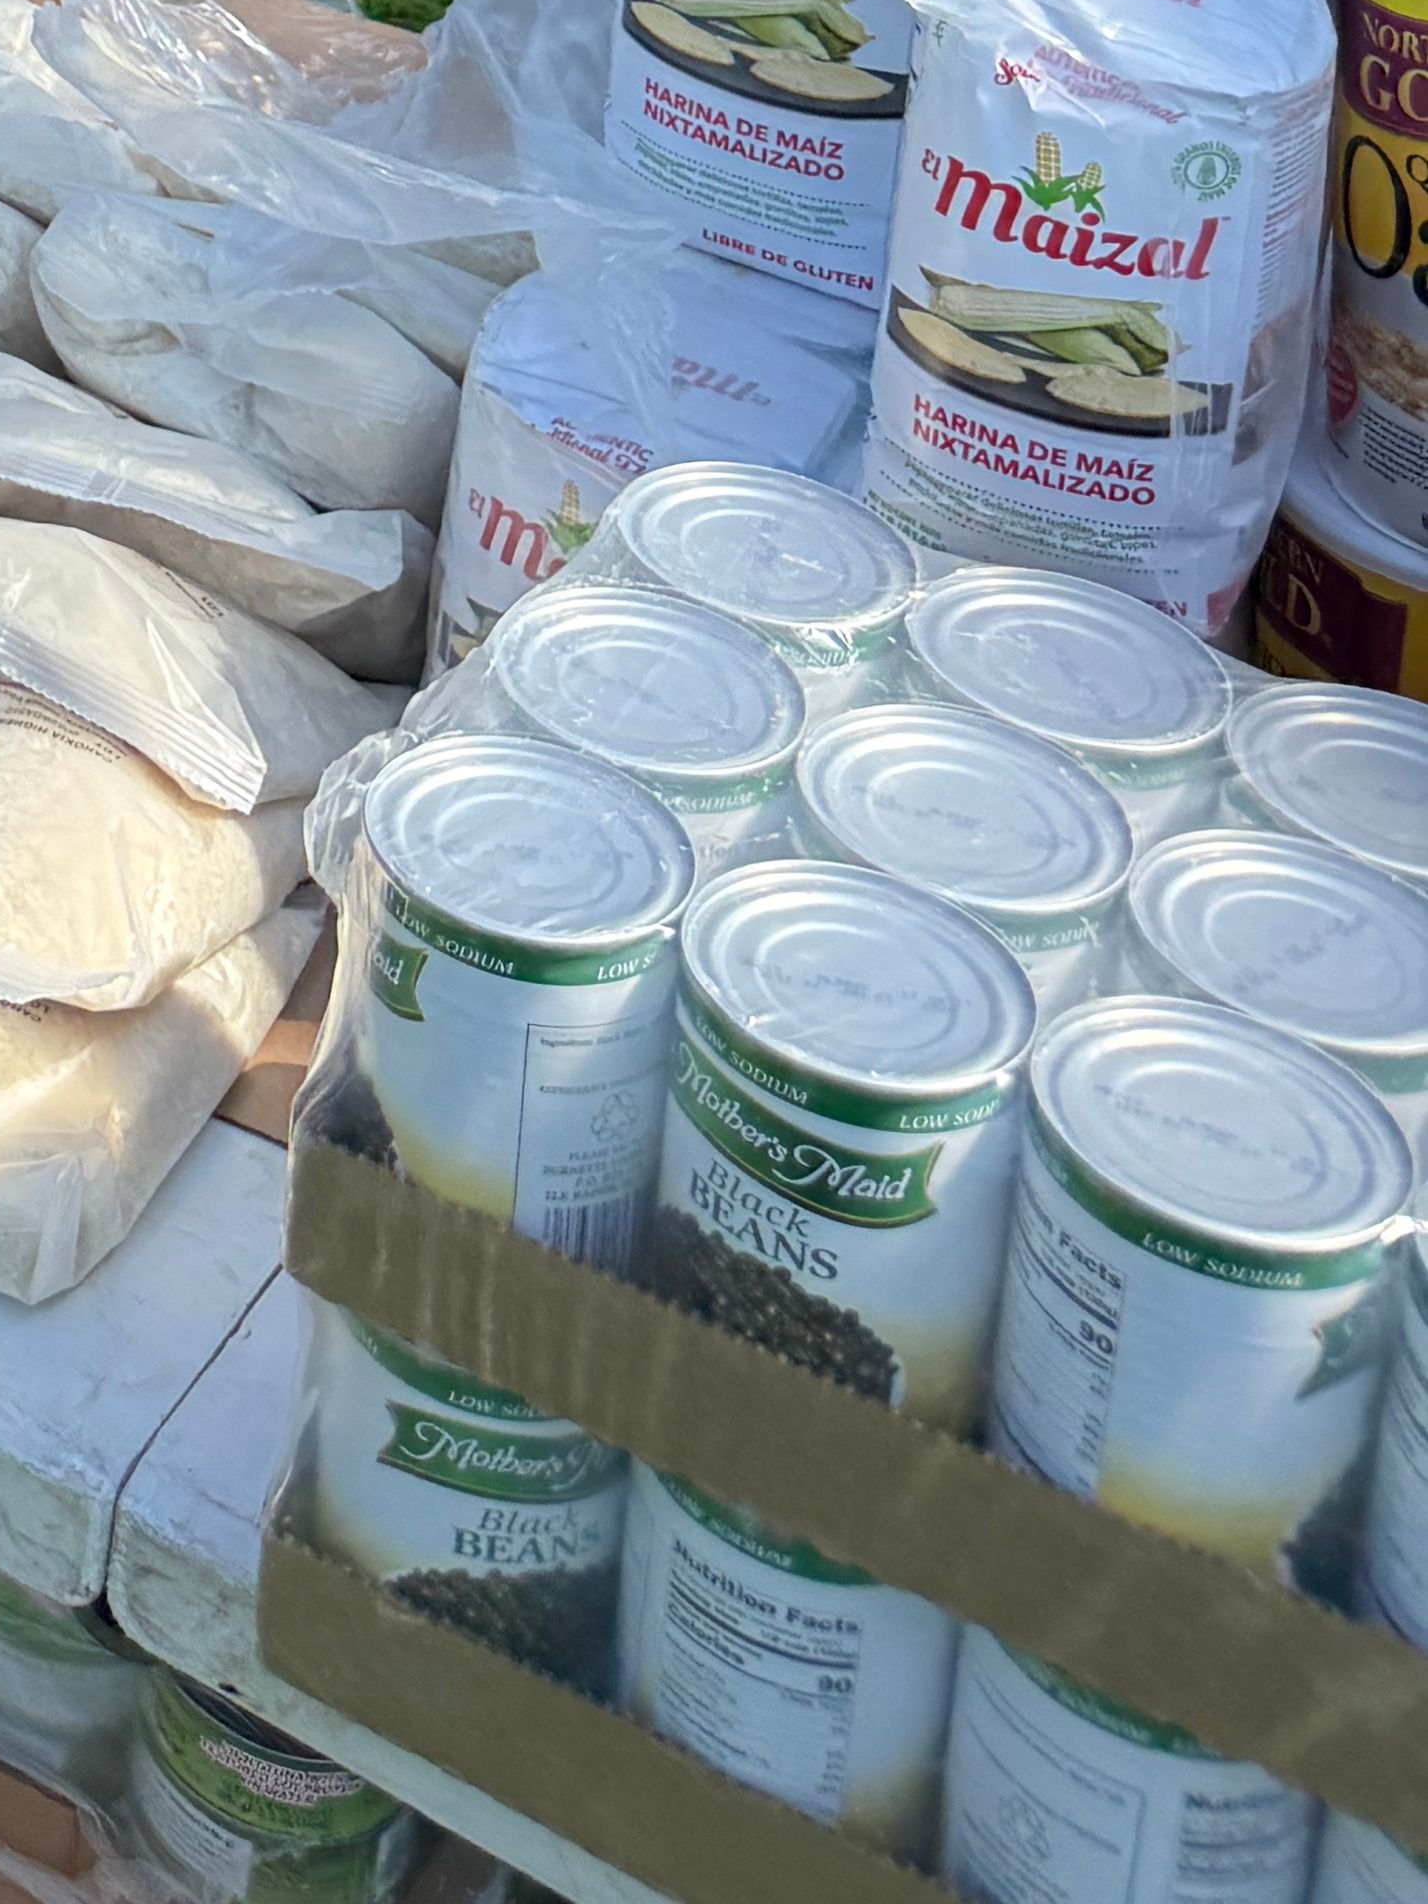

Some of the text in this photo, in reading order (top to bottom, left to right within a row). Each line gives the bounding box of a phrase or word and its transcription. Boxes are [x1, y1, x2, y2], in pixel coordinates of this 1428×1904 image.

[644, 100, 844, 181] NIXTAMALIZADO
[645, 77, 844, 160] HARINA DE MAÍZ
[921, 148, 941, 181] El
[934, 155, 1219, 281] Maizal
[702, 228, 874, 291] LIBRE DE GLUTEN
[913, 394, 1156, 482] HARINA DE MAÍZ
[913, 418, 1156, 506] NIXTAMALIZADO
[369, 934, 405, 986] aid
[436, 933, 516, 976] SODIUM
[597, 959, 640, 981] LOW
[695, 1015, 809, 1106] LOW SODIUM
[672, 1040, 789, 1164] Mother's
[771, 1144, 913, 1201] Maid
[899, 1114, 947, 1130] LOW
[689, 1167, 839, 1282] BEANS
[707, 1157, 812, 1239] Black
[1059, 1229, 1122, 1291] Facts
[1143, 1230, 1305, 1290] LOW SODIUM
[1078, 1318, 1114, 1356] 90
[447, 1389, 494, 1415] LOW
[399, 1419, 565, 1478] Mother's
[479, 1501, 580, 1536] Black
[673, 1538, 778, 1618] Nutrition
[785, 1607, 861, 1634] Facts
[817, 1674, 854, 1694] 90
